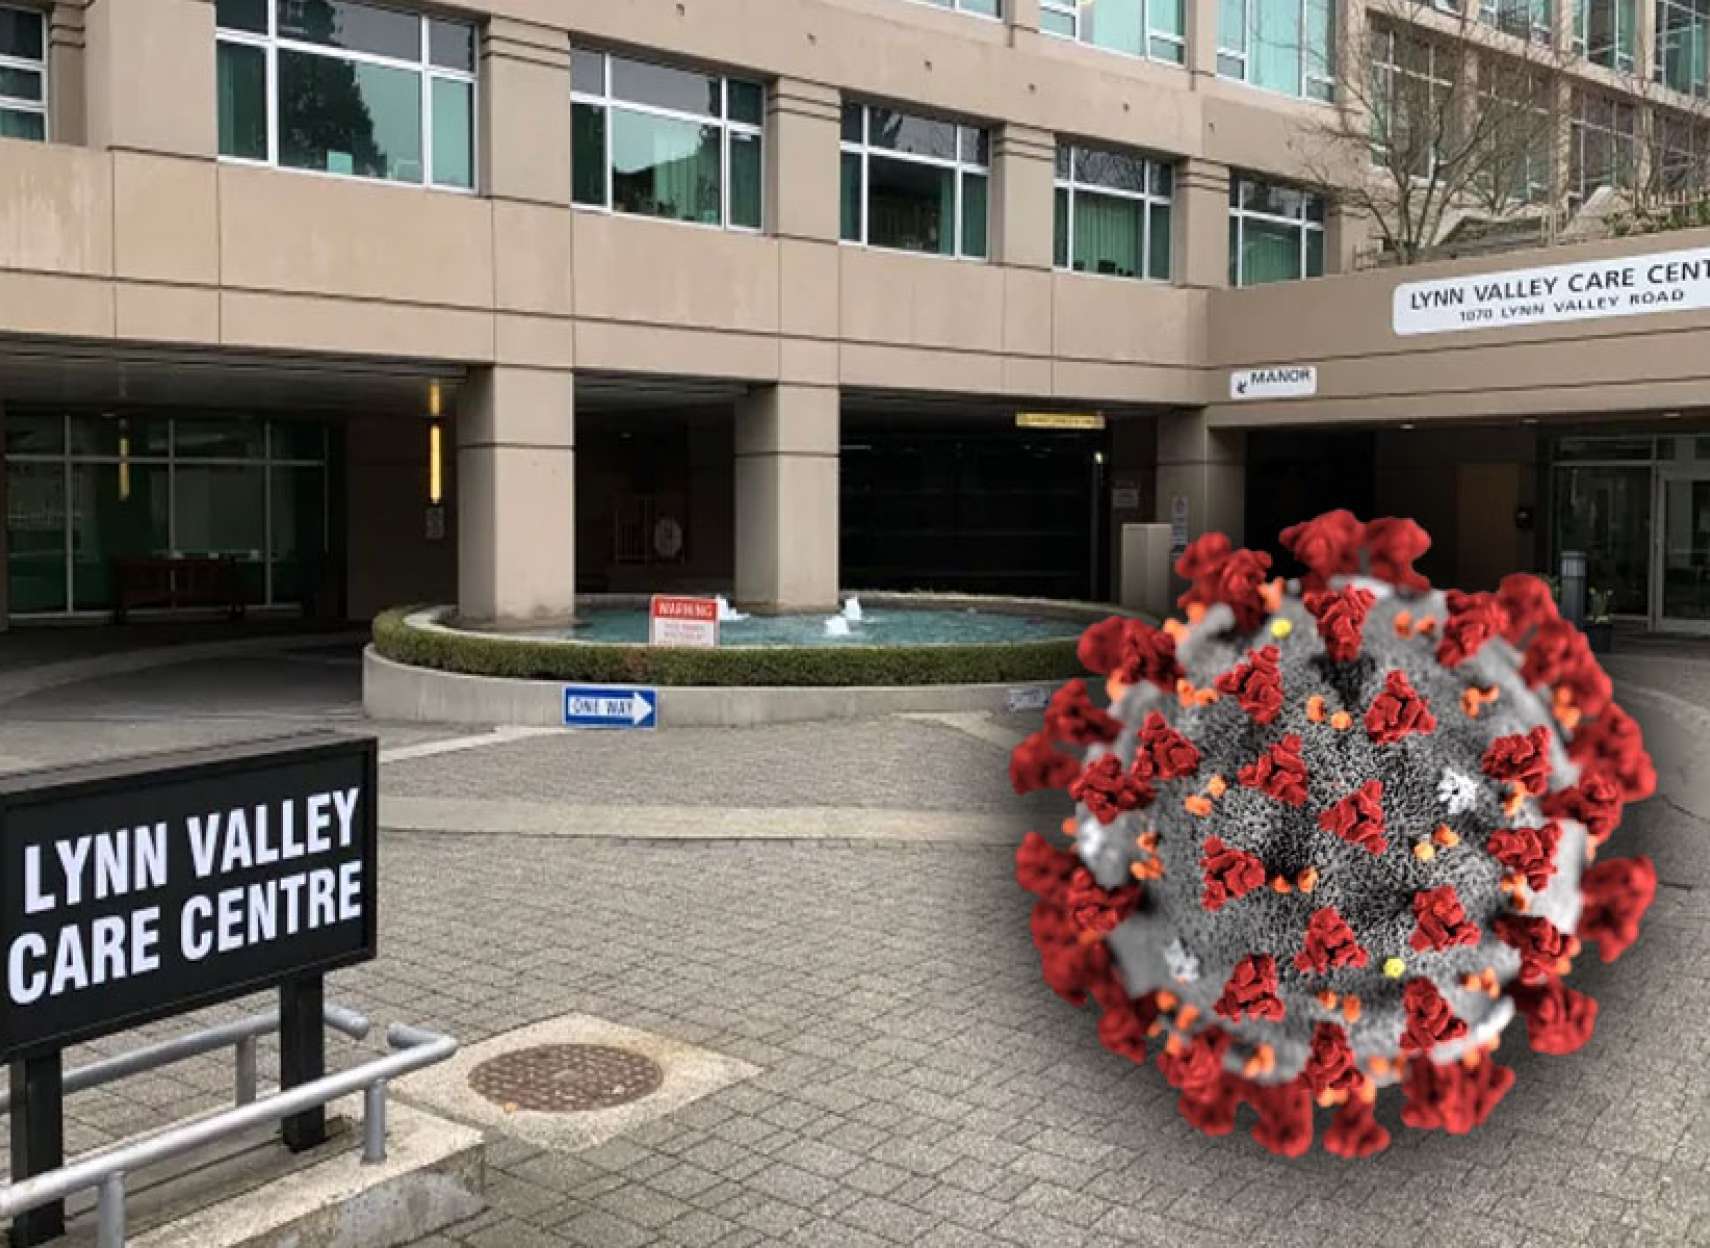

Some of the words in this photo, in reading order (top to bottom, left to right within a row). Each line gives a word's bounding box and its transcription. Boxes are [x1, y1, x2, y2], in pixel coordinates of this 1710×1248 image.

[1410, 286, 1464, 310] LYNN
[1473, 276, 1559, 302] VALLEY
[1568, 267, 1635, 292] CARE
[1501, 303, 1545, 319] LYNN
[1554, 296, 1619, 314] VALLEY
[1630, 289, 1684, 305] ROAD
[1250, 369, 1310, 384] MANOR
[658, 601, 713, 617] WARNING
[573, 698, 598, 714] ONE
[606, 699, 633, 714] WAY
[25, 822, 168, 914] LYNN
[186, 787, 360, 877] VALLEY
[8, 905, 160, 1006] CARE
[180, 859, 362, 961] CENTRE
